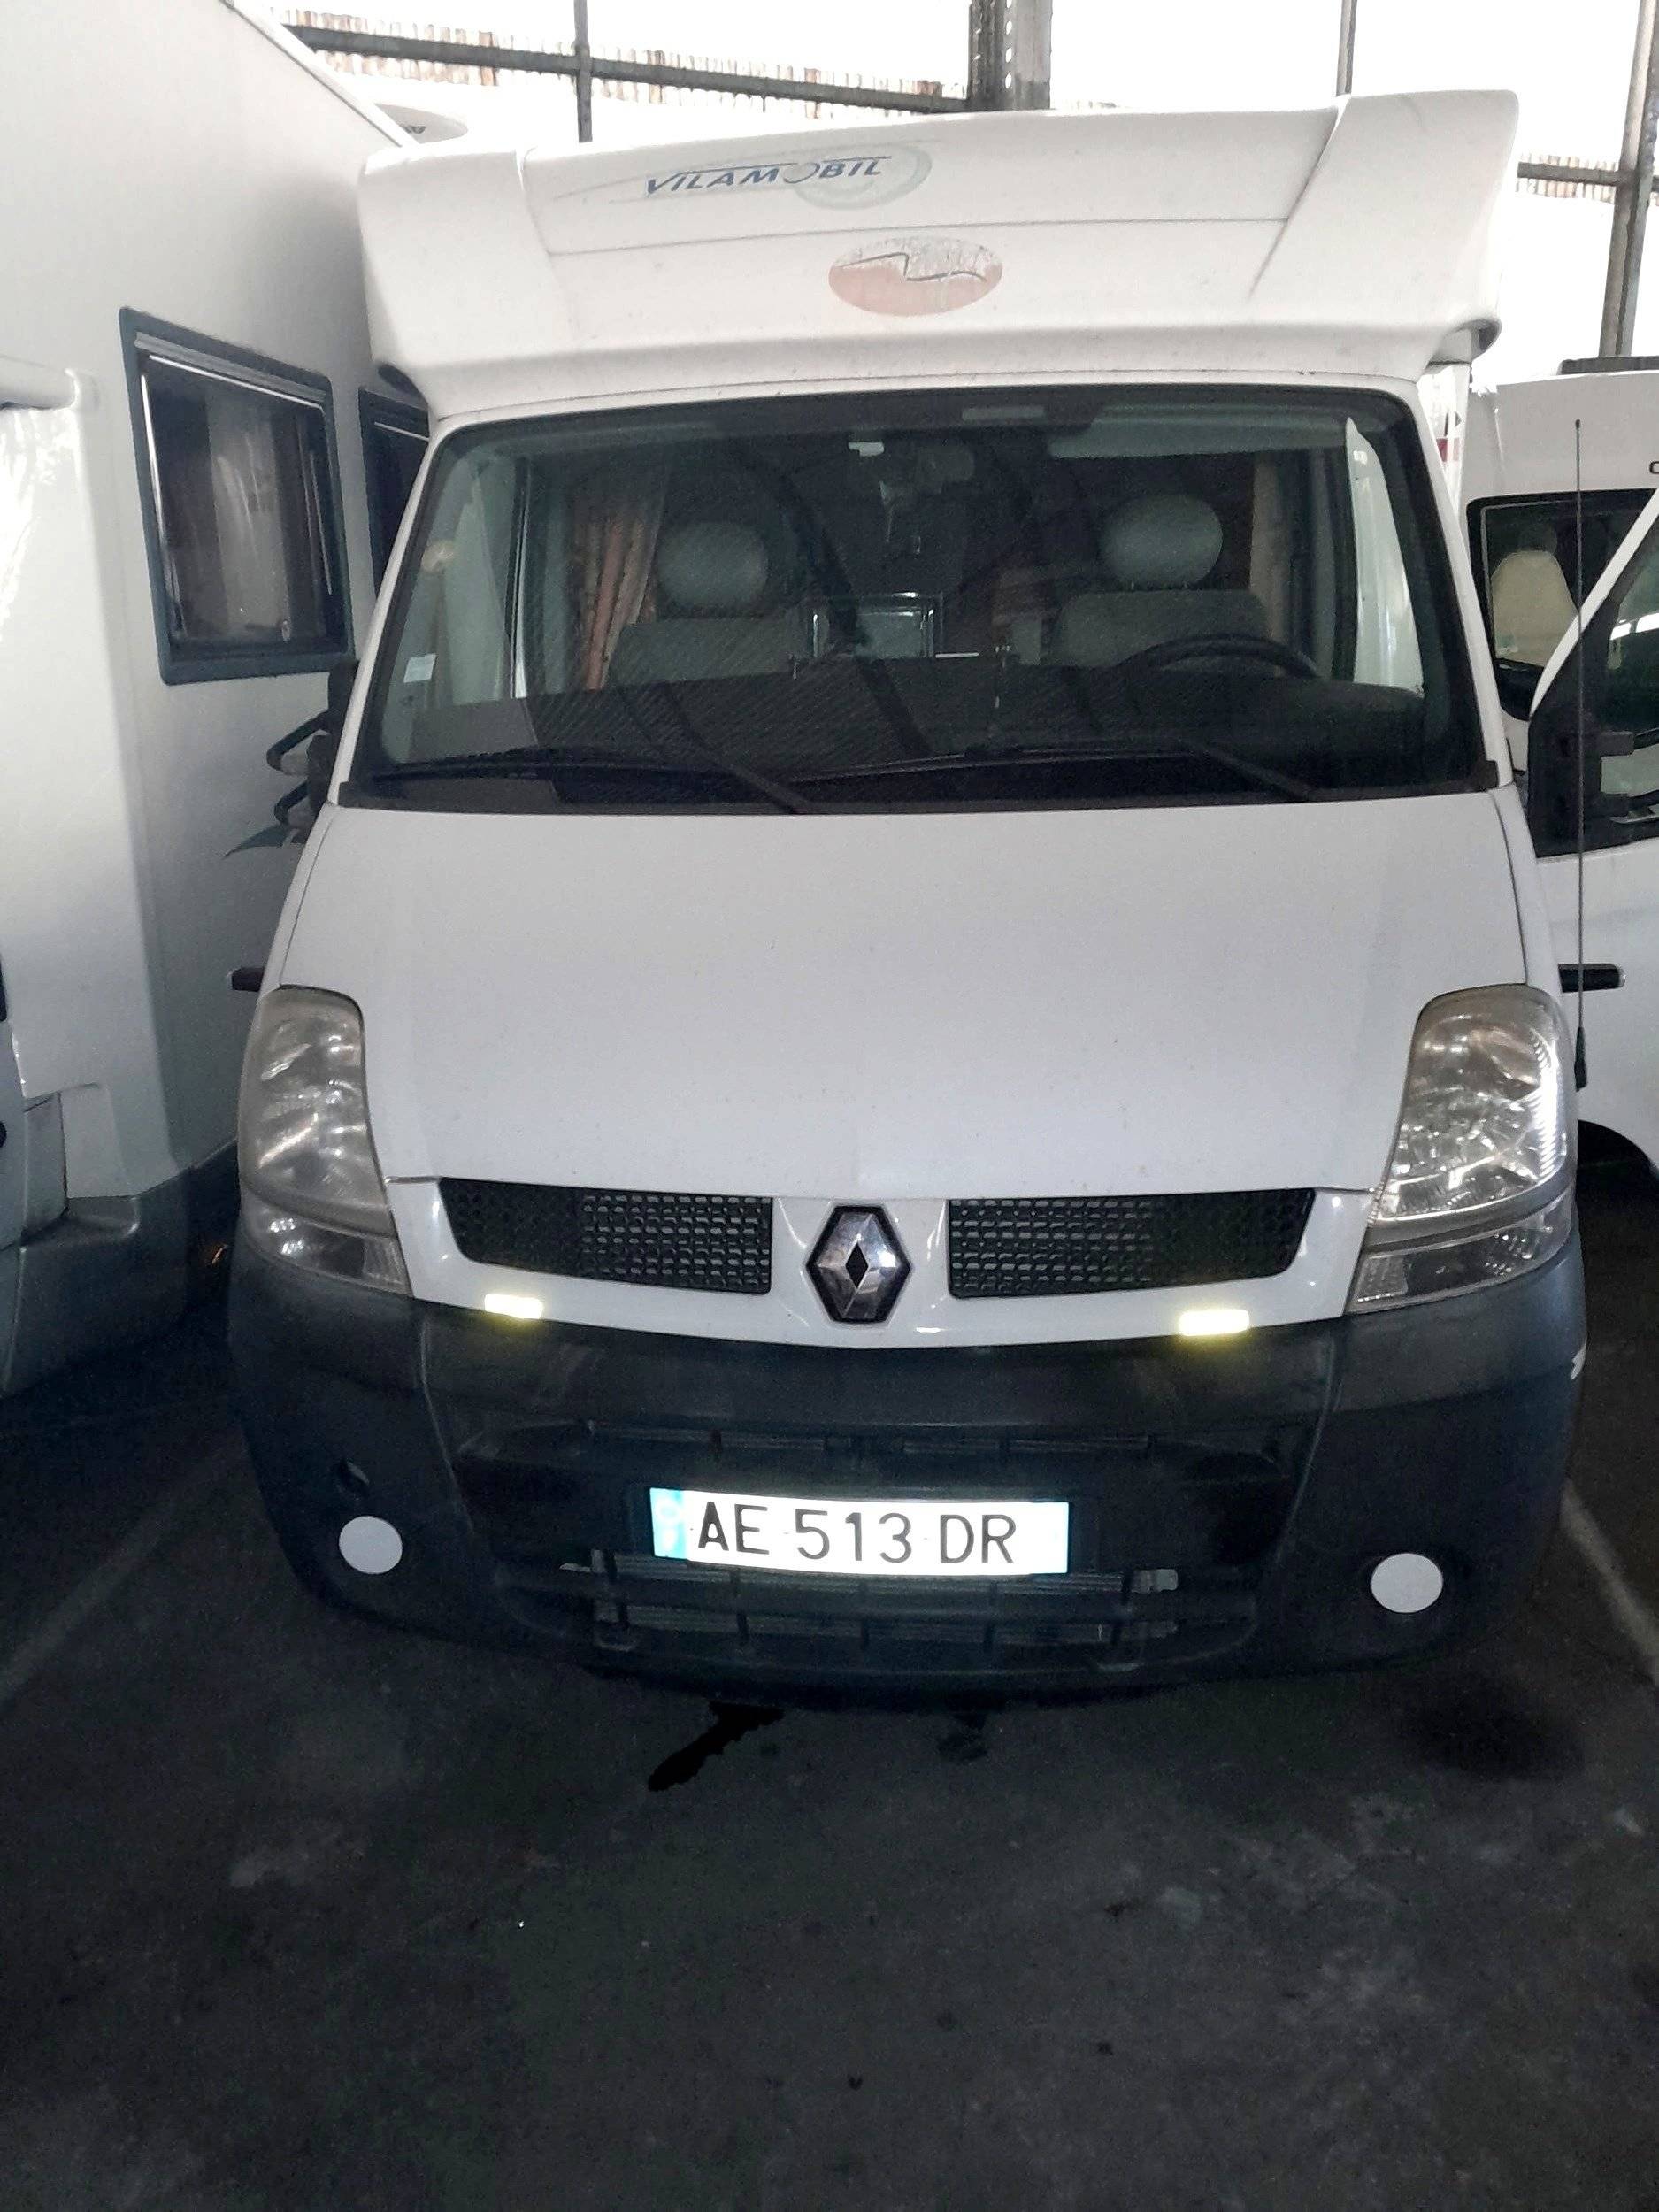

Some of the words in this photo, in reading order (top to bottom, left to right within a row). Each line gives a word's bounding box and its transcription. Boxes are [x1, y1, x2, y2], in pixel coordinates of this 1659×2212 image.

[646, 156, 891, 194] VILAMOBIL
[697, 1502, 769, 1555] AE
[795, 1509, 912, 1563] 513
[940, 1514, 1017, 1563] DR
